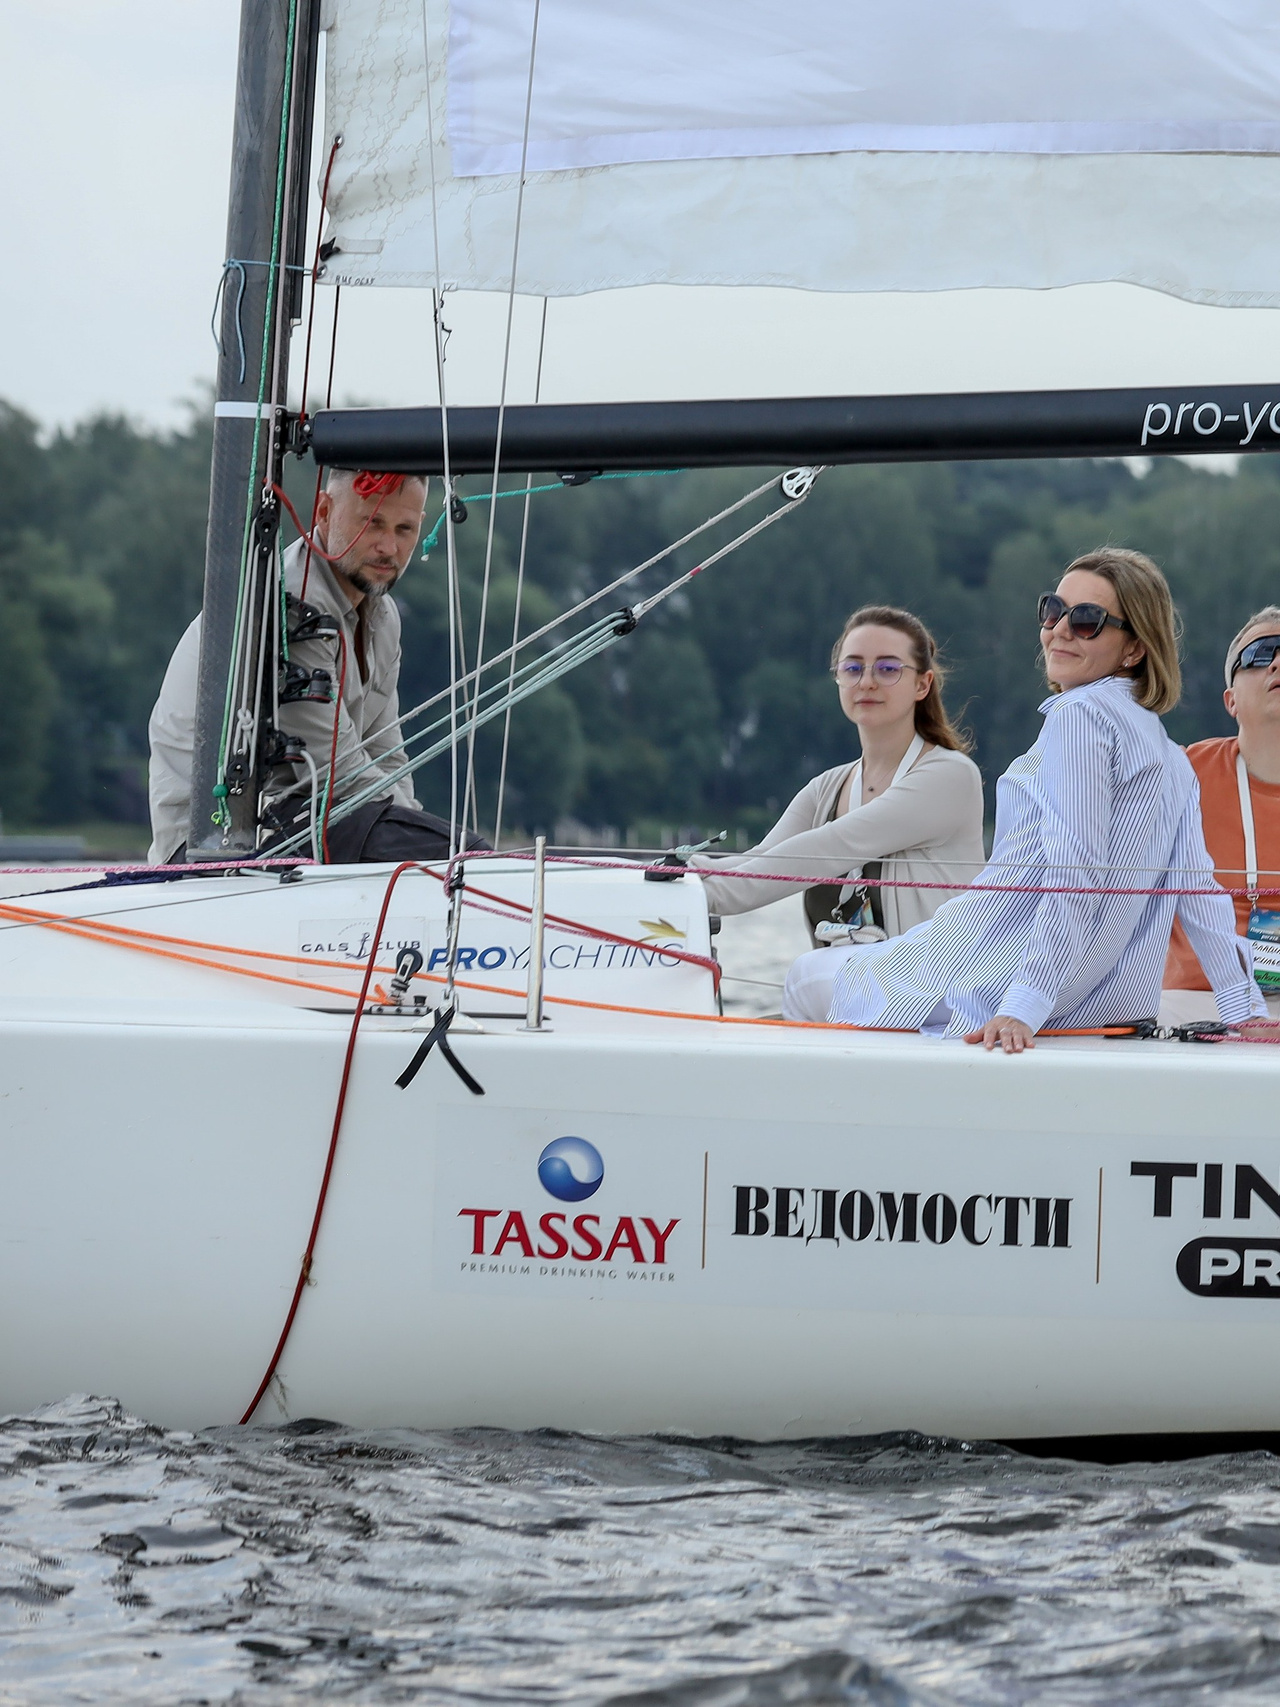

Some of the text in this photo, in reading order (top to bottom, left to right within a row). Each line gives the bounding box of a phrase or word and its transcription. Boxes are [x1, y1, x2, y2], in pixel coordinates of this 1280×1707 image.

[457, 1208, 682, 1264] TASSAY
[732, 1186, 1073, 1249] ВЕДОМОСТИ
[461, 1262, 676, 1283] PREMIUM DRINKING WATER
